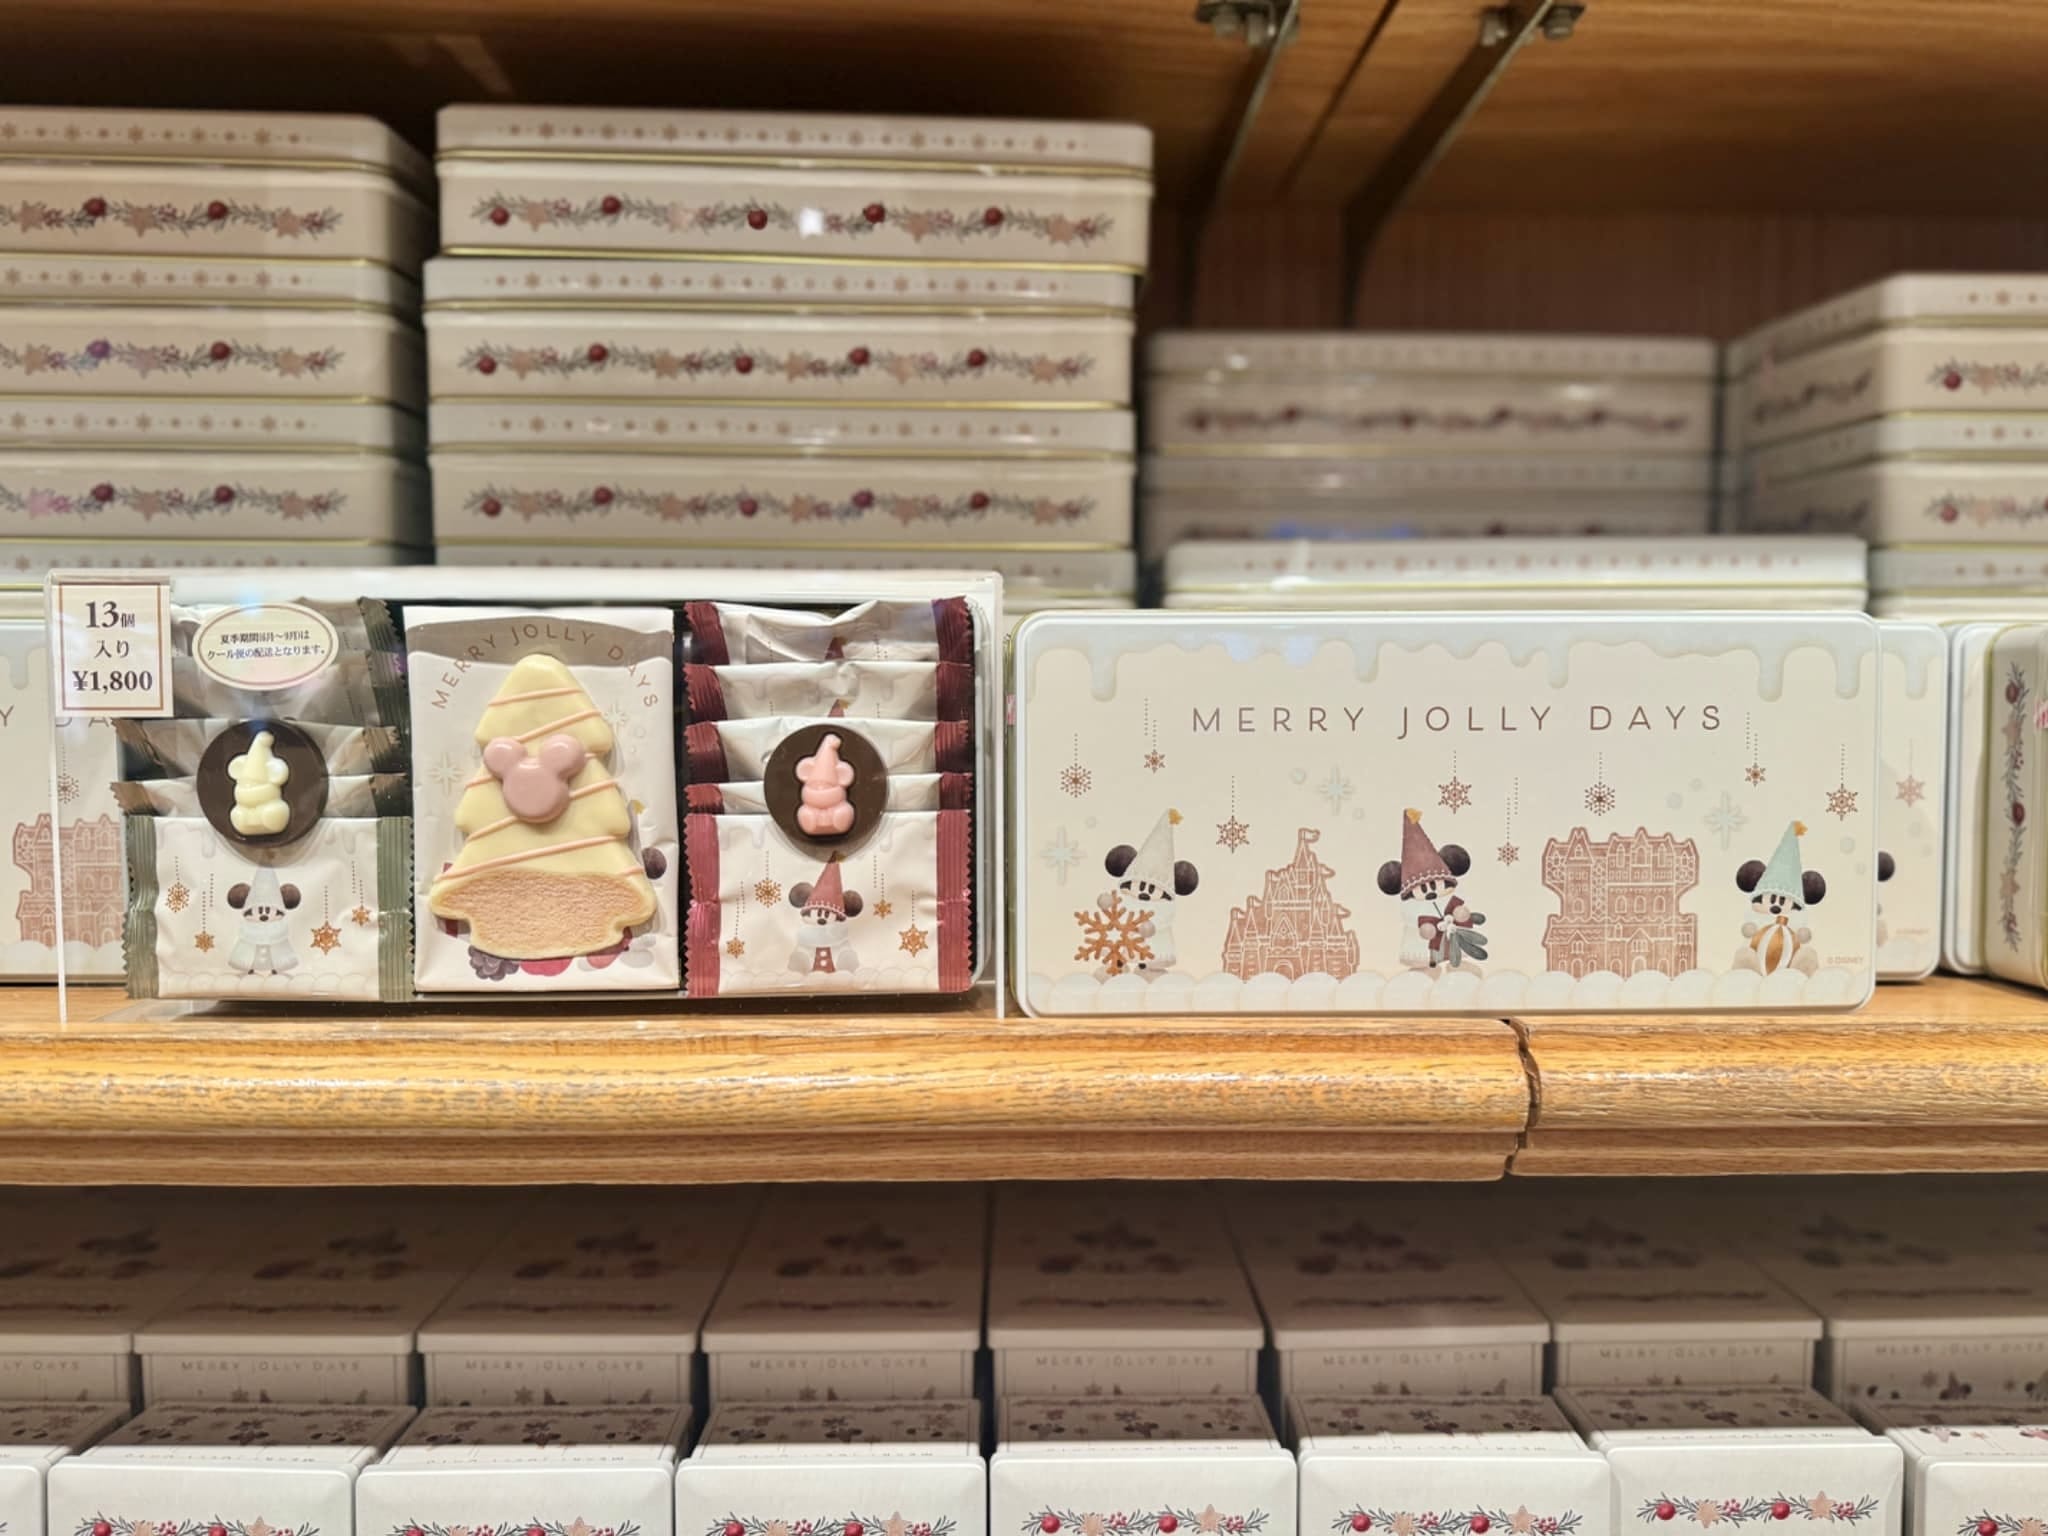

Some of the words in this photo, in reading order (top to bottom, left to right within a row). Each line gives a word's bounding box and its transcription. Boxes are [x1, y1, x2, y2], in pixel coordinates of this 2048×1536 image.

[85, 600, 136, 629] 13個
[94, 639, 130, 659] 入り
[431, 634, 497, 709] MERRY
[510, 623, 596, 646] JOLLY
[607, 644, 659, 708] DAYS
[72, 670, 153, 694] ¥1,800
[1192, 706, 1364, 732] MERRY
[1396, 706, 1551, 740] JOLLY
[1589, 705, 1721, 731] DAYS
